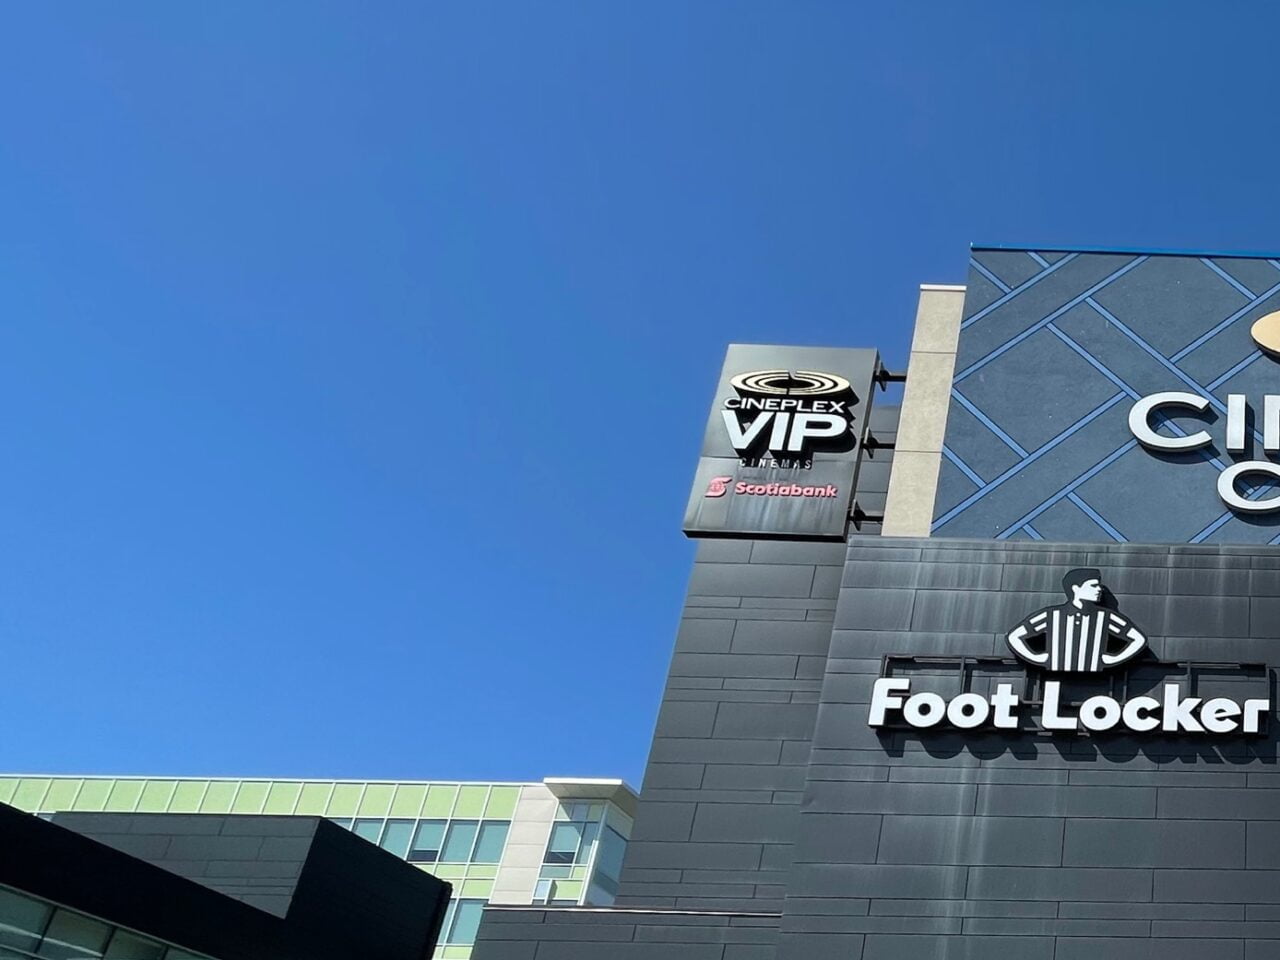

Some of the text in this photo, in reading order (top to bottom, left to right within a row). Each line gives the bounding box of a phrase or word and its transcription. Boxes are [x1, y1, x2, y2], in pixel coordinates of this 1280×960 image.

[723, 397, 846, 414] CINEPLEX
[720, 409, 848, 452] VIP
[738, 457, 812, 470] CINEMAS
[735, 481, 838, 498] Scotiabank
[867, 677, 1270, 734] Foot Locker
